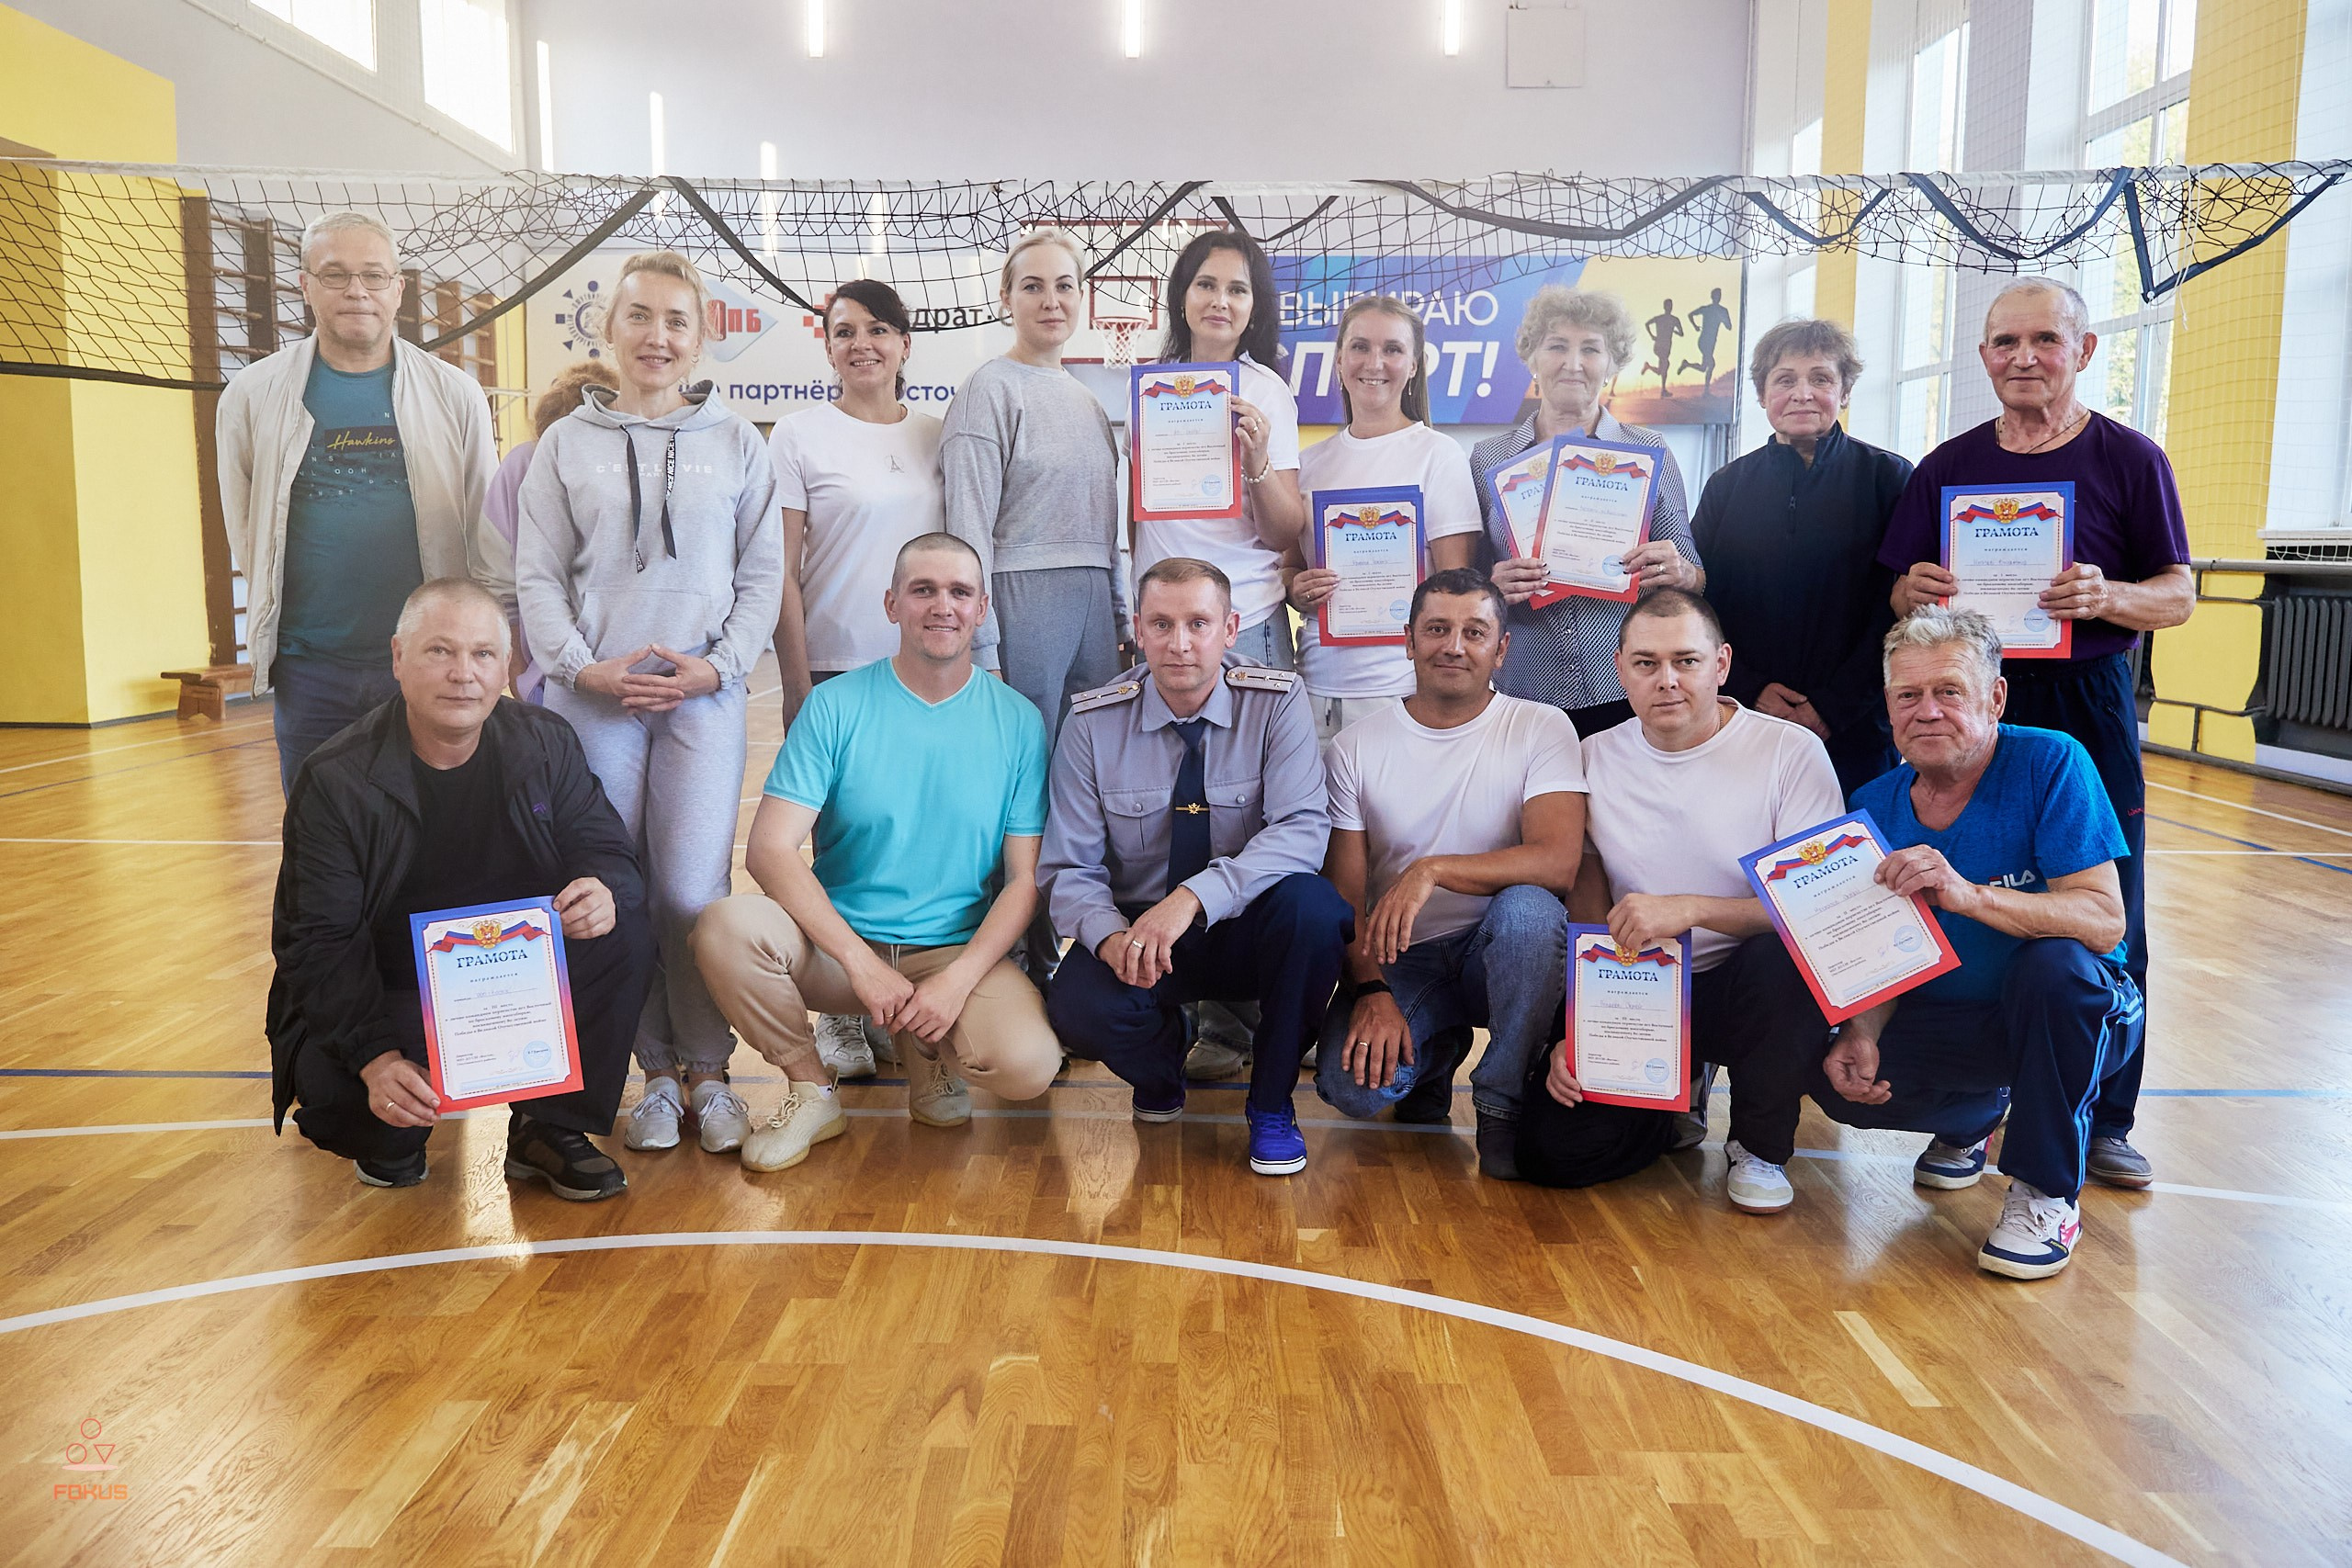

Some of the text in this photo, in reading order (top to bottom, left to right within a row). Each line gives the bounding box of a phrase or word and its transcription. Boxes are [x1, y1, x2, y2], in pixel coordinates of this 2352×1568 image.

[1279, 290, 1499, 326] ВЫРАЮ
[1159, 400, 1212, 412] ГРАМОТА
[327, 431, 396, 450] Hawkins
[596, 462, 647, 473] C'ET
[682, 464, 713, 474] VIE
[1575, 476, 1629, 491] ГРАМОТА
[1345, 531, 1397, 542] ГРАМОТА
[1974, 526, 2039, 538] ГРАМОТА
[1792, 854, 1859, 889] ГРАМОТА
[1989, 869, 2036, 888] FILA
[457, 949, 528, 968] ГРАМОТА
[1599, 968, 1658, 982] ГРАМОТА
